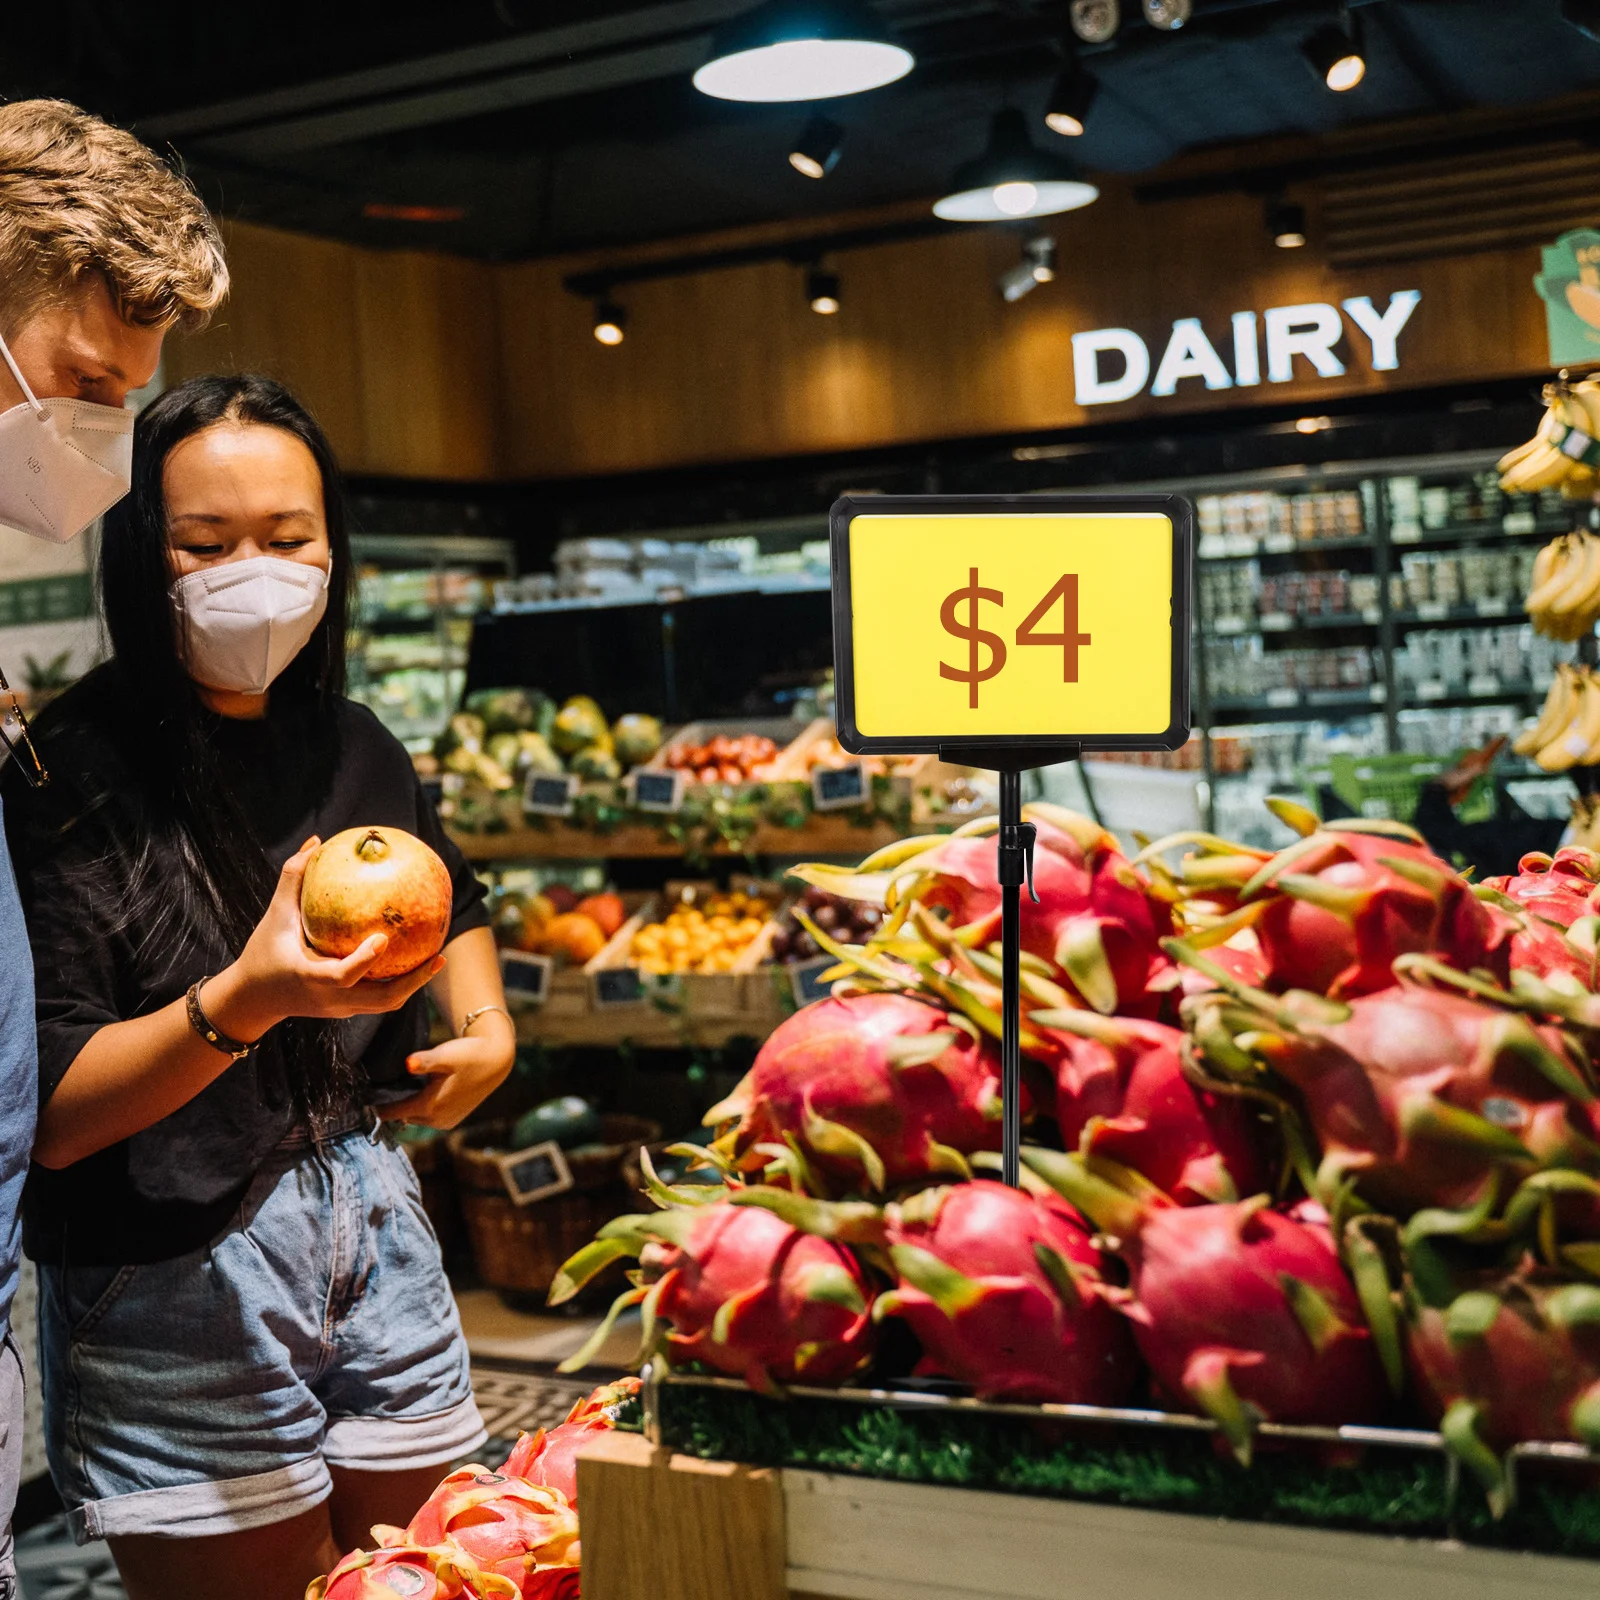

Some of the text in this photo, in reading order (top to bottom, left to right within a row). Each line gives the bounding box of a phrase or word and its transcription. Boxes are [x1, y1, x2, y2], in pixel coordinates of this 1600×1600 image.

[1070, 290, 1421, 406] DAIRY
[24, 455, 43, 474] N95
[939, 568, 1092, 709] $4
